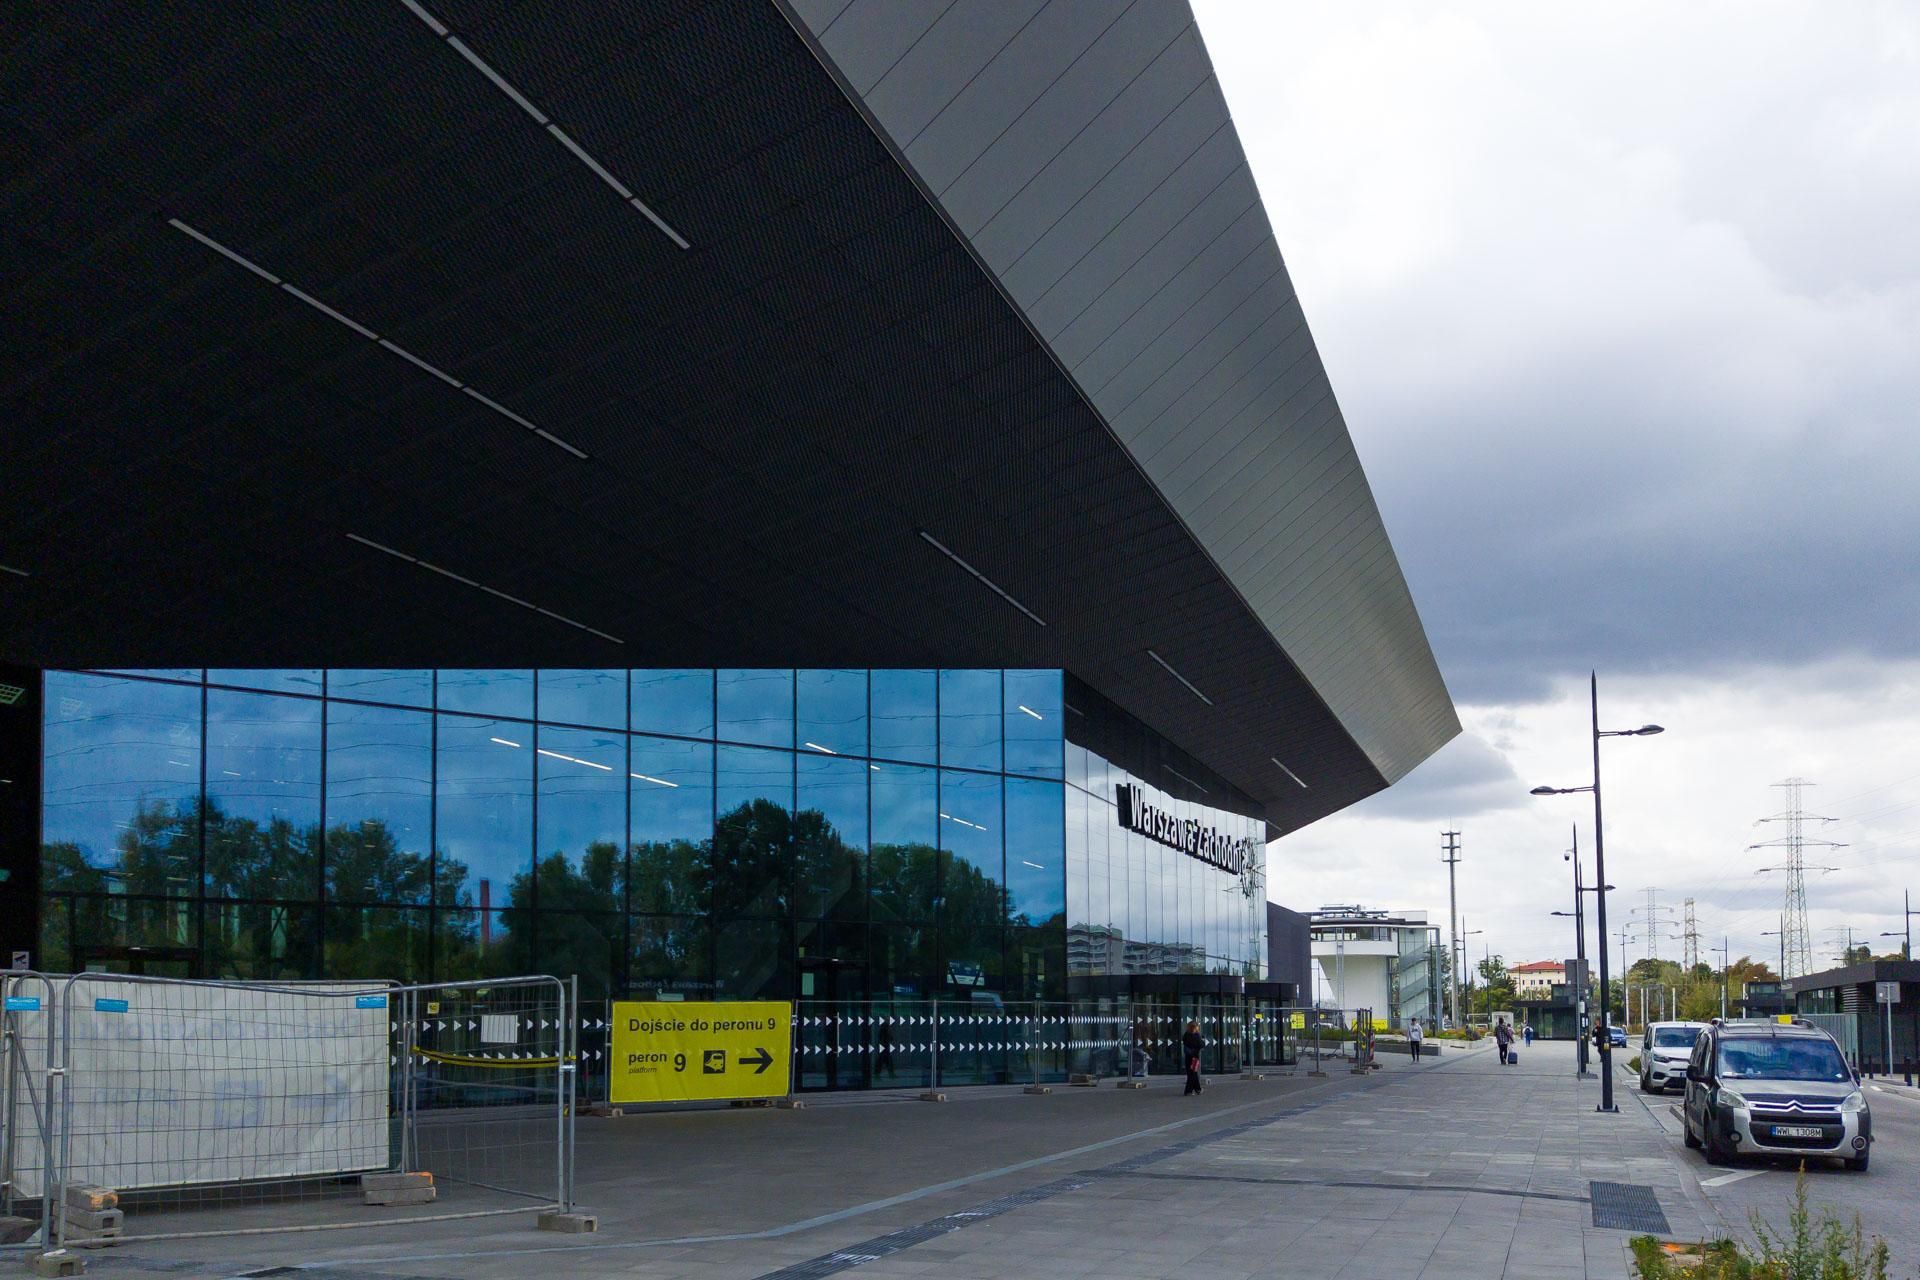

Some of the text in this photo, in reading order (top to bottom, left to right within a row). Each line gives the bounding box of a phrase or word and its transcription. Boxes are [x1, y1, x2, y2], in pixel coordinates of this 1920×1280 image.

[1117, 783, 1248, 874] Warszawa Zachodnia
[629, 1017, 776, 1034] Dojście do peronu 9
[628, 1052, 687, 1073] peron 9
[628, 1066, 658, 1074] platform
[1776, 1127, 1793, 1136] WWL
